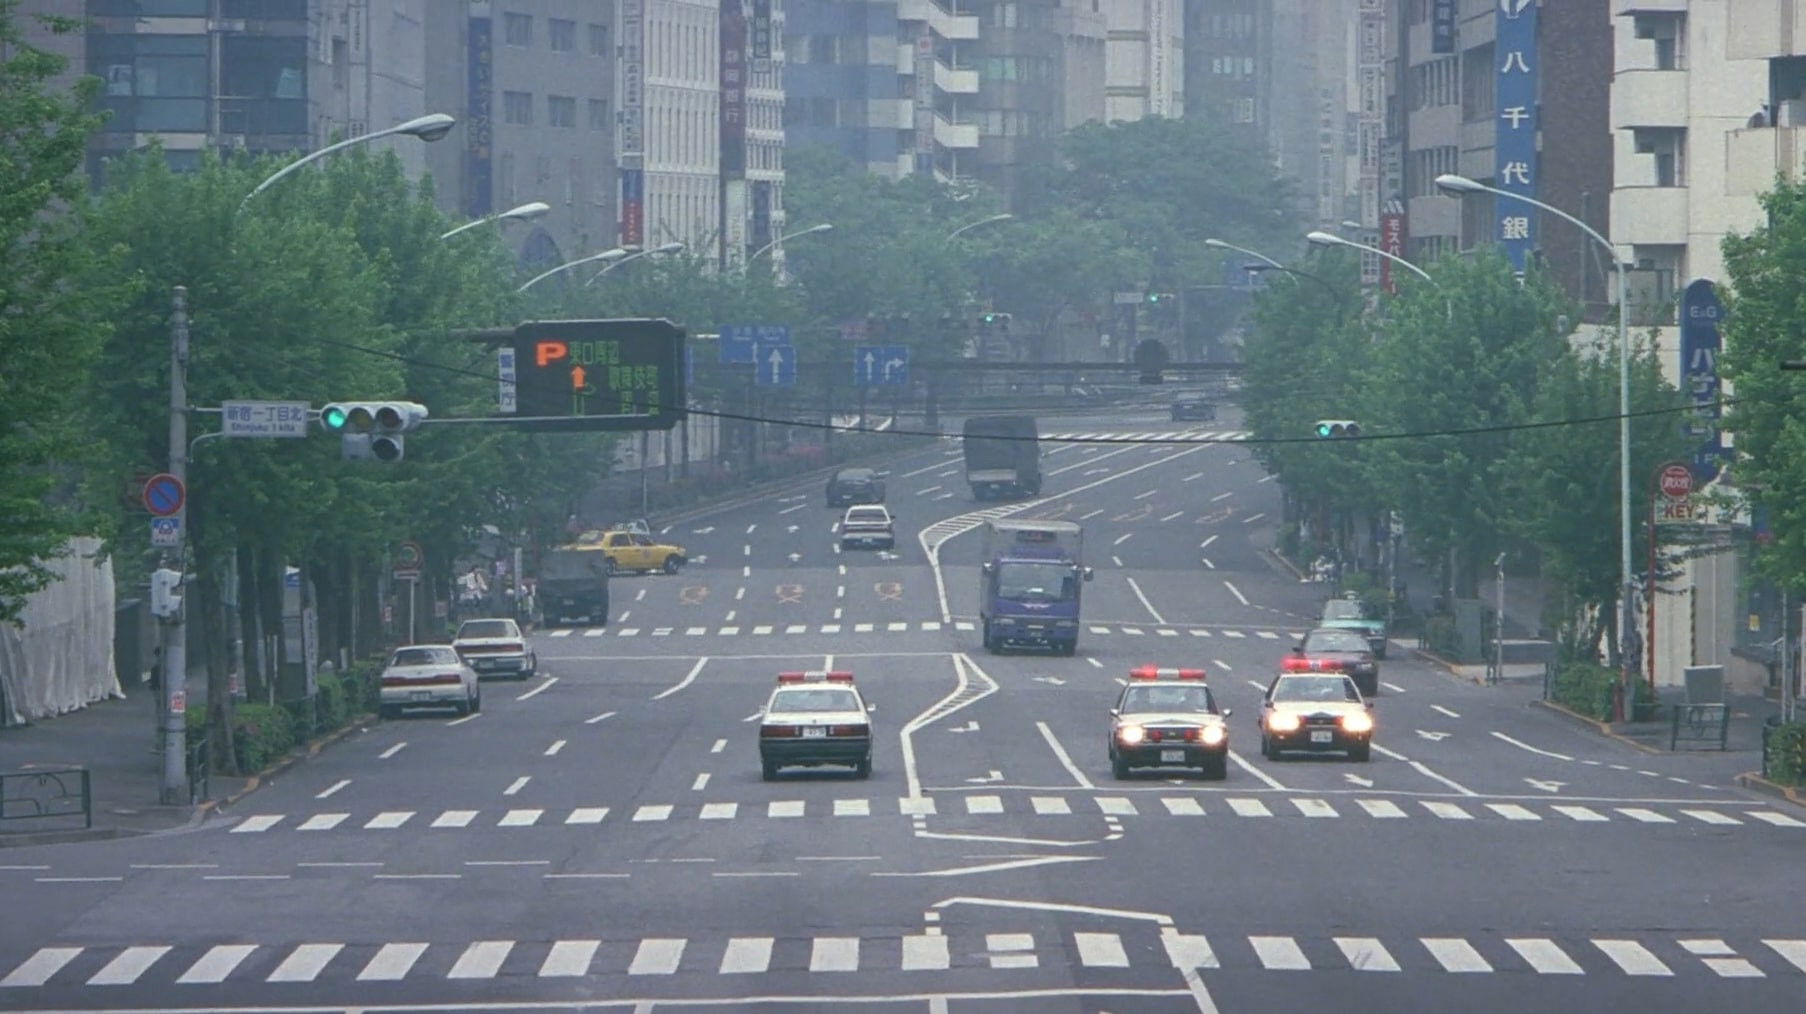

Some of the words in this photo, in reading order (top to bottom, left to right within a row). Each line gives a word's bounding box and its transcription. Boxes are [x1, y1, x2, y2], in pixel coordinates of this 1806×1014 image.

[536, 342, 567, 366] P
[227, 405, 303, 421] 新宿一丁目北
[1664, 504, 1696, 518] KEY
